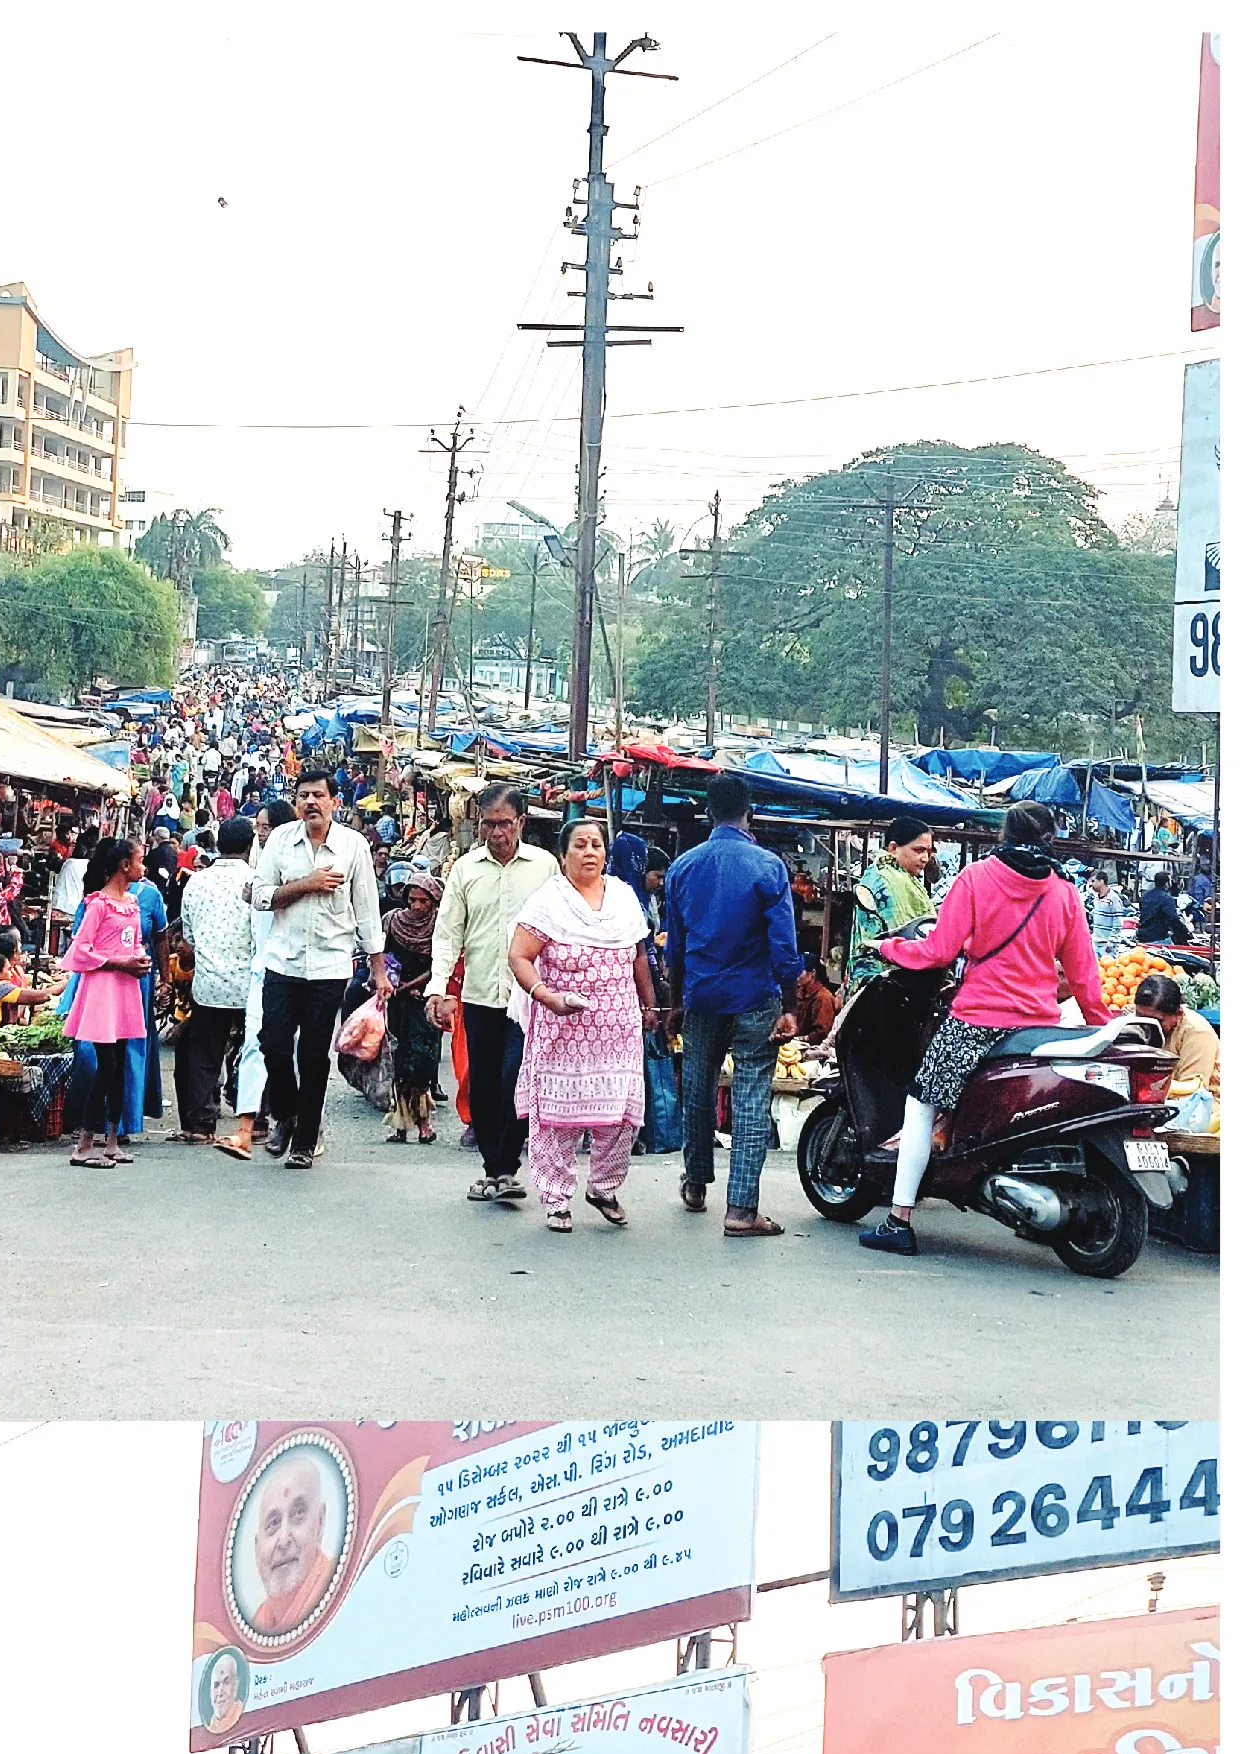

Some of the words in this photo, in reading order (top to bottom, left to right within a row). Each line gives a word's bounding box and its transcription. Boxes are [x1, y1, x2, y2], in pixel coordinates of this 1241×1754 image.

[514, 1446, 551, 1471] ૨૦૨૨
[556, 1433, 573, 1456] થી
[472, 1531, 498, 1554] રોજ
[501, 1516, 536, 1545] બપોરે
[581, 1495, 598, 1519] થી
[867, 1499, 975, 1562] 079
[991, 1459, 1220, 1547] 26444
[461, 1555, 507, 1586] રવિવારે
[510, 1544, 545, 1572] સવારે
[590, 1524, 608, 1548] થી
[511, 1590, 618, 1630] live.psm100.org
[525, 1714, 562, 1745] સેવા
[571, 1700, 631, 1733] સમિતિ
